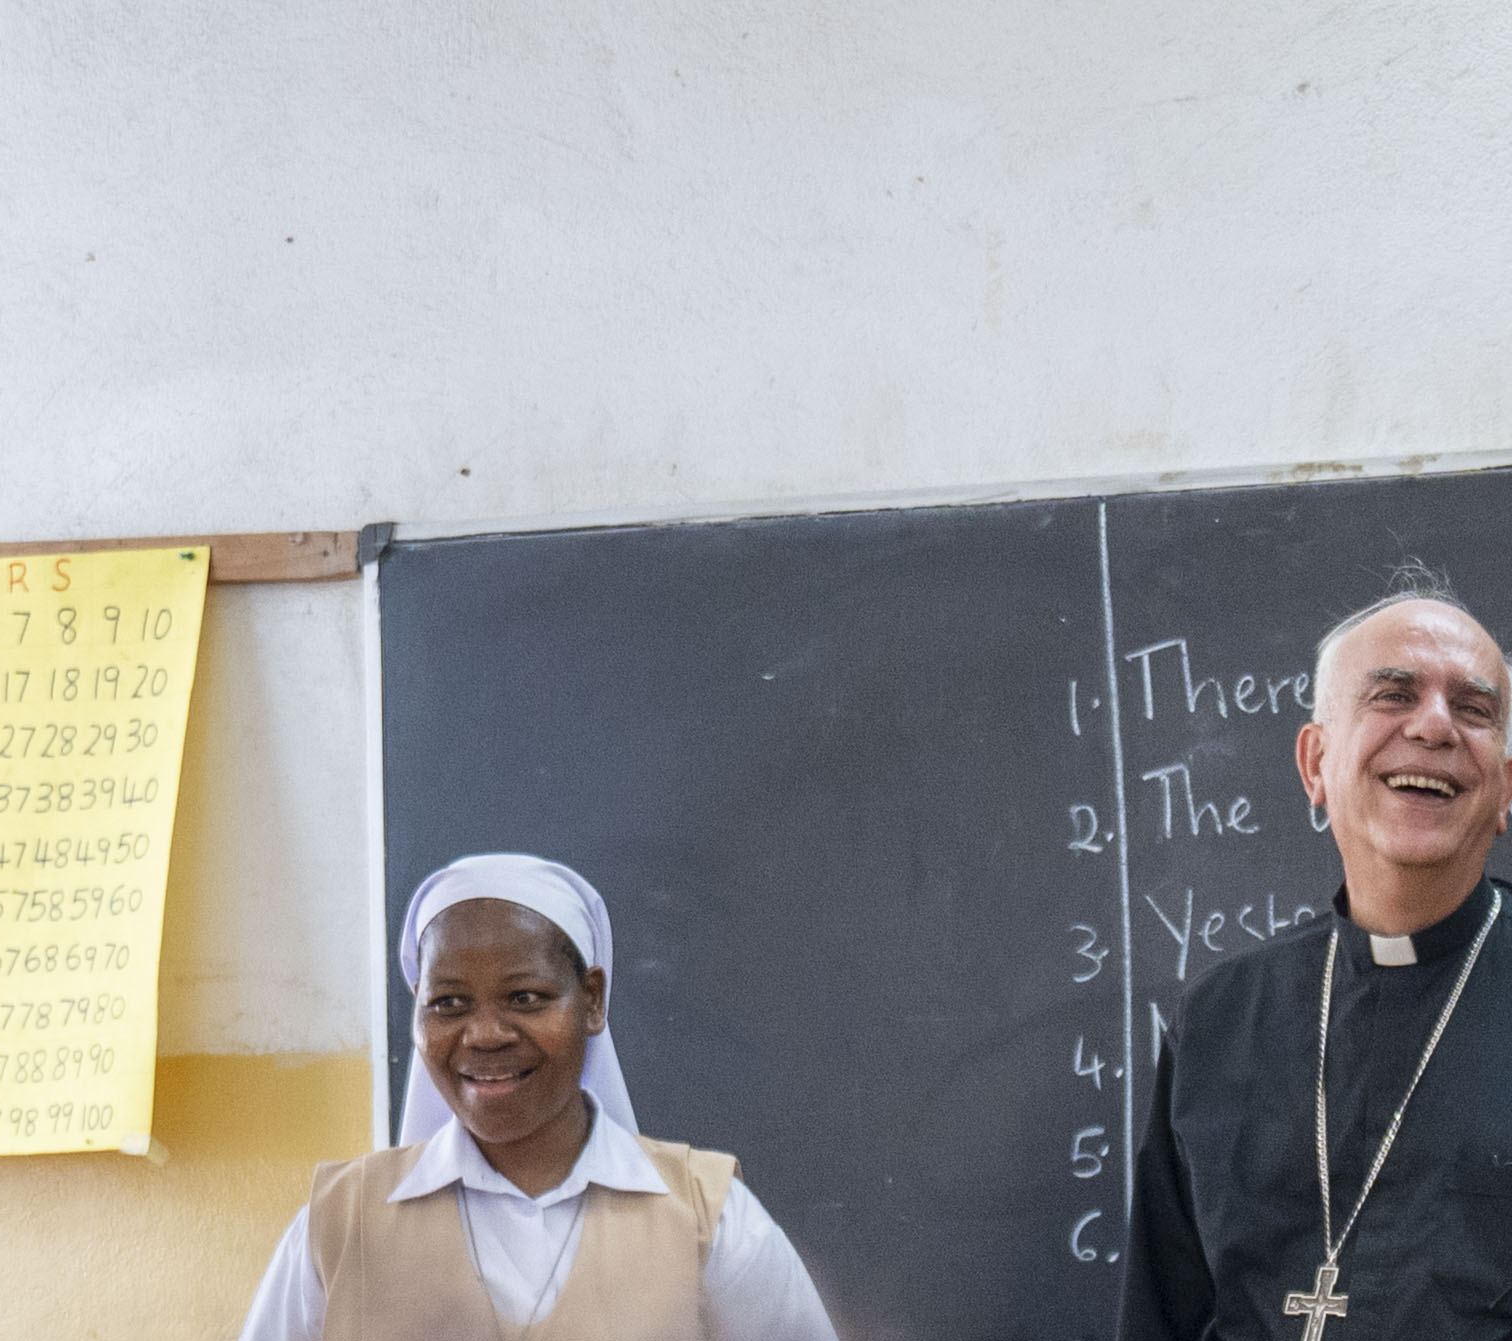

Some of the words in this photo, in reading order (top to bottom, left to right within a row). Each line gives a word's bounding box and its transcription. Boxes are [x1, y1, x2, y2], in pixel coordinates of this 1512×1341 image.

[13, 613, 30, 644] 7
[58, 608, 76, 643] 8
[105, 607, 120, 643] 9
[143, 608, 172, 640] 10
[5, 671, 30, 703] 17
[50, 669, 80, 702] 18
[94, 667, 120, 700] 19
[132, 666, 168, 697] 20
[1068, 680, 1102, 736] 1.
[1125, 638, 1312, 720] There
[41, 725, 75, 756] 28
[84, 725, 116, 755] 29
[127, 720, 158, 751] 30
[35, 783, 74, 812] 38
[79, 779, 115, 810] 39
[122, 778, 157, 807] 40
[1069, 806, 1114, 853] 2.
[1142, 763, 1260, 840] The
[33, 838, 72, 868] 48
[75, 837, 111, 864] 49
[114, 834, 150, 861] 50
[27, 889, 63, 920] 58
[72, 888, 104, 918] 59
[109, 889, 143, 915] 60
[24, 945, 60, 971] 68
[66, 944, 96, 969] 69
[104, 943, 130, 969] 70
[20, 1002, 52, 1030] 78
[59, 998, 90, 1024] 79
[94, 994, 126, 1023] 80
[15, 1051, 51, 1083] 88
[54, 1047, 83, 1080] 89
[88, 1048, 114, 1074] 90
[1074, 1037, 1124, 1090] 4.
[10, 1107, 38, 1136] 98
[48, 1104, 73, 1132] 99
[81, 1104, 114, 1131] 100
[1071, 1212, 1119, 1263] 6.
